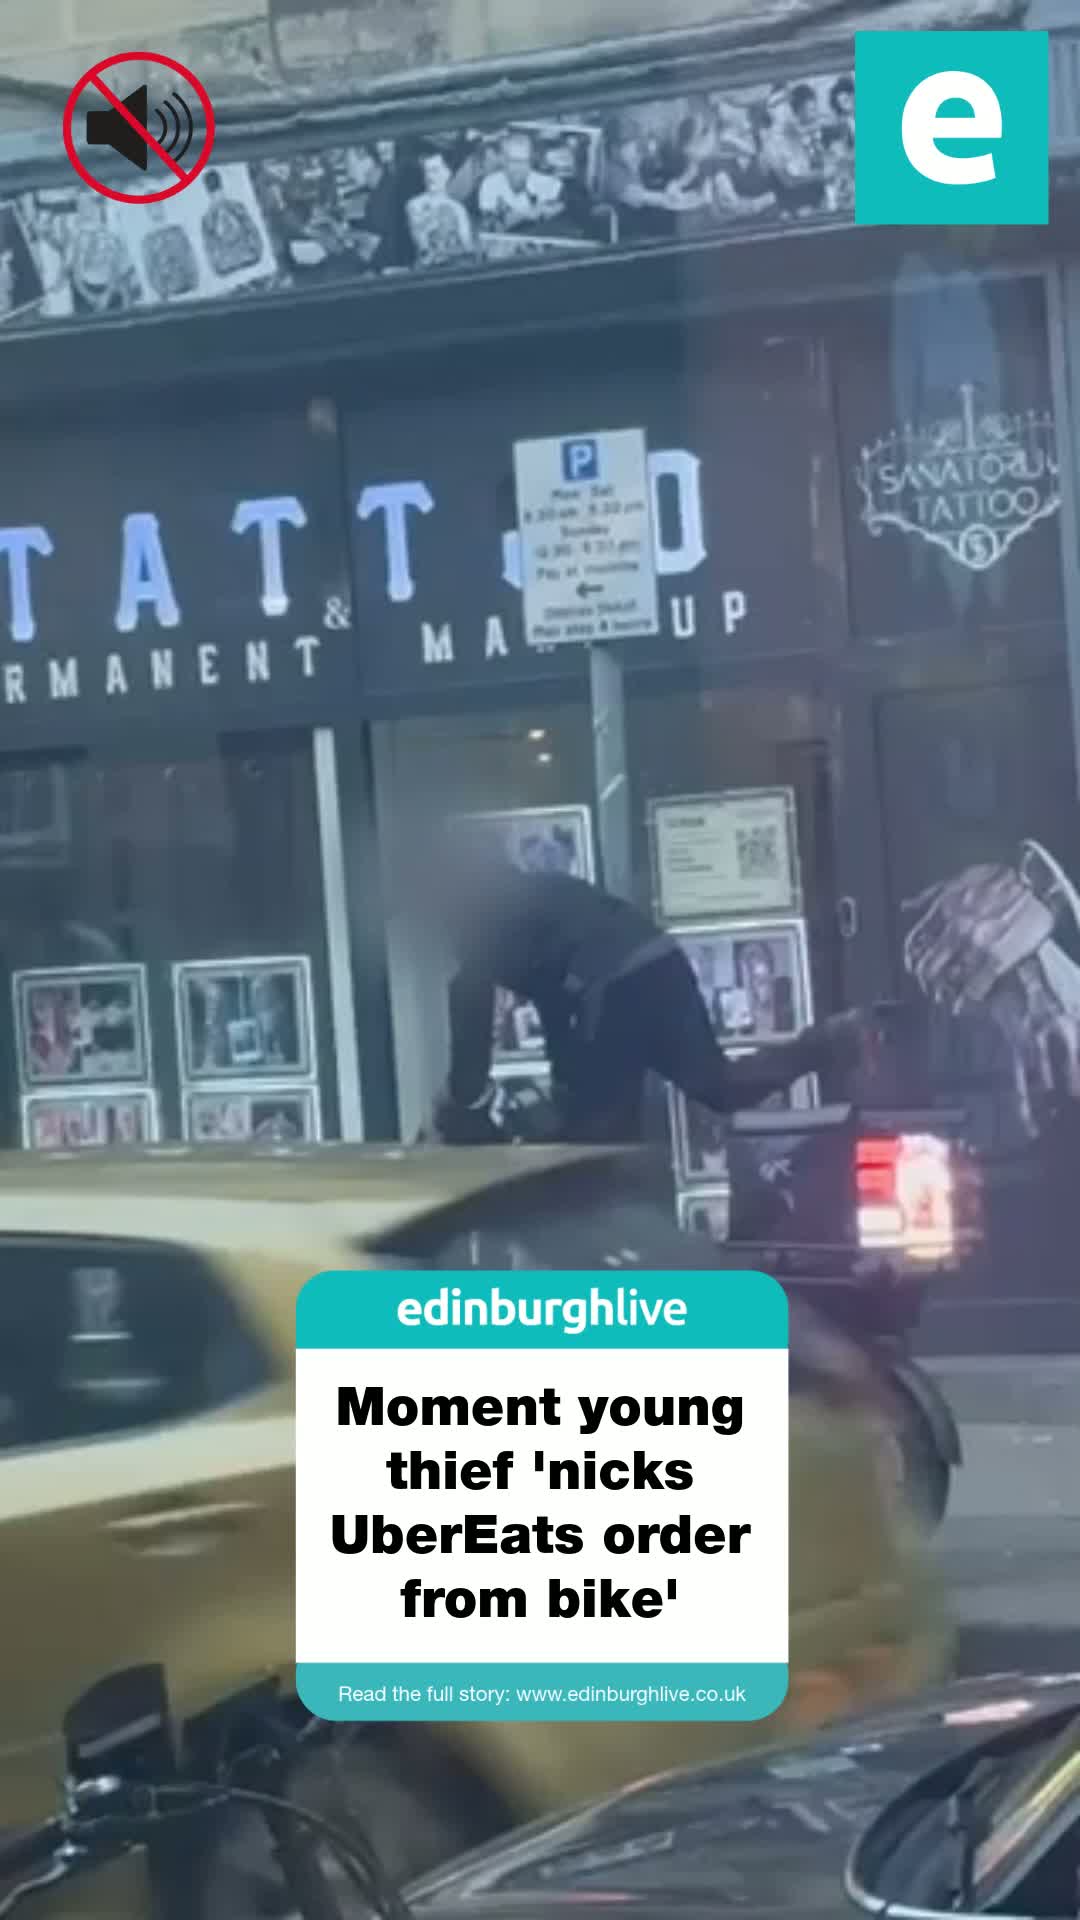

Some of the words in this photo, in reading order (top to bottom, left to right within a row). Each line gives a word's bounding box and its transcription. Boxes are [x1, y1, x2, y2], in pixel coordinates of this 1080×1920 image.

[569, 444, 594, 480] P
[913, 486, 1040, 526] TATTOO
[0, 449, 707, 643] TATTO
[323, 596, 352, 630] &
